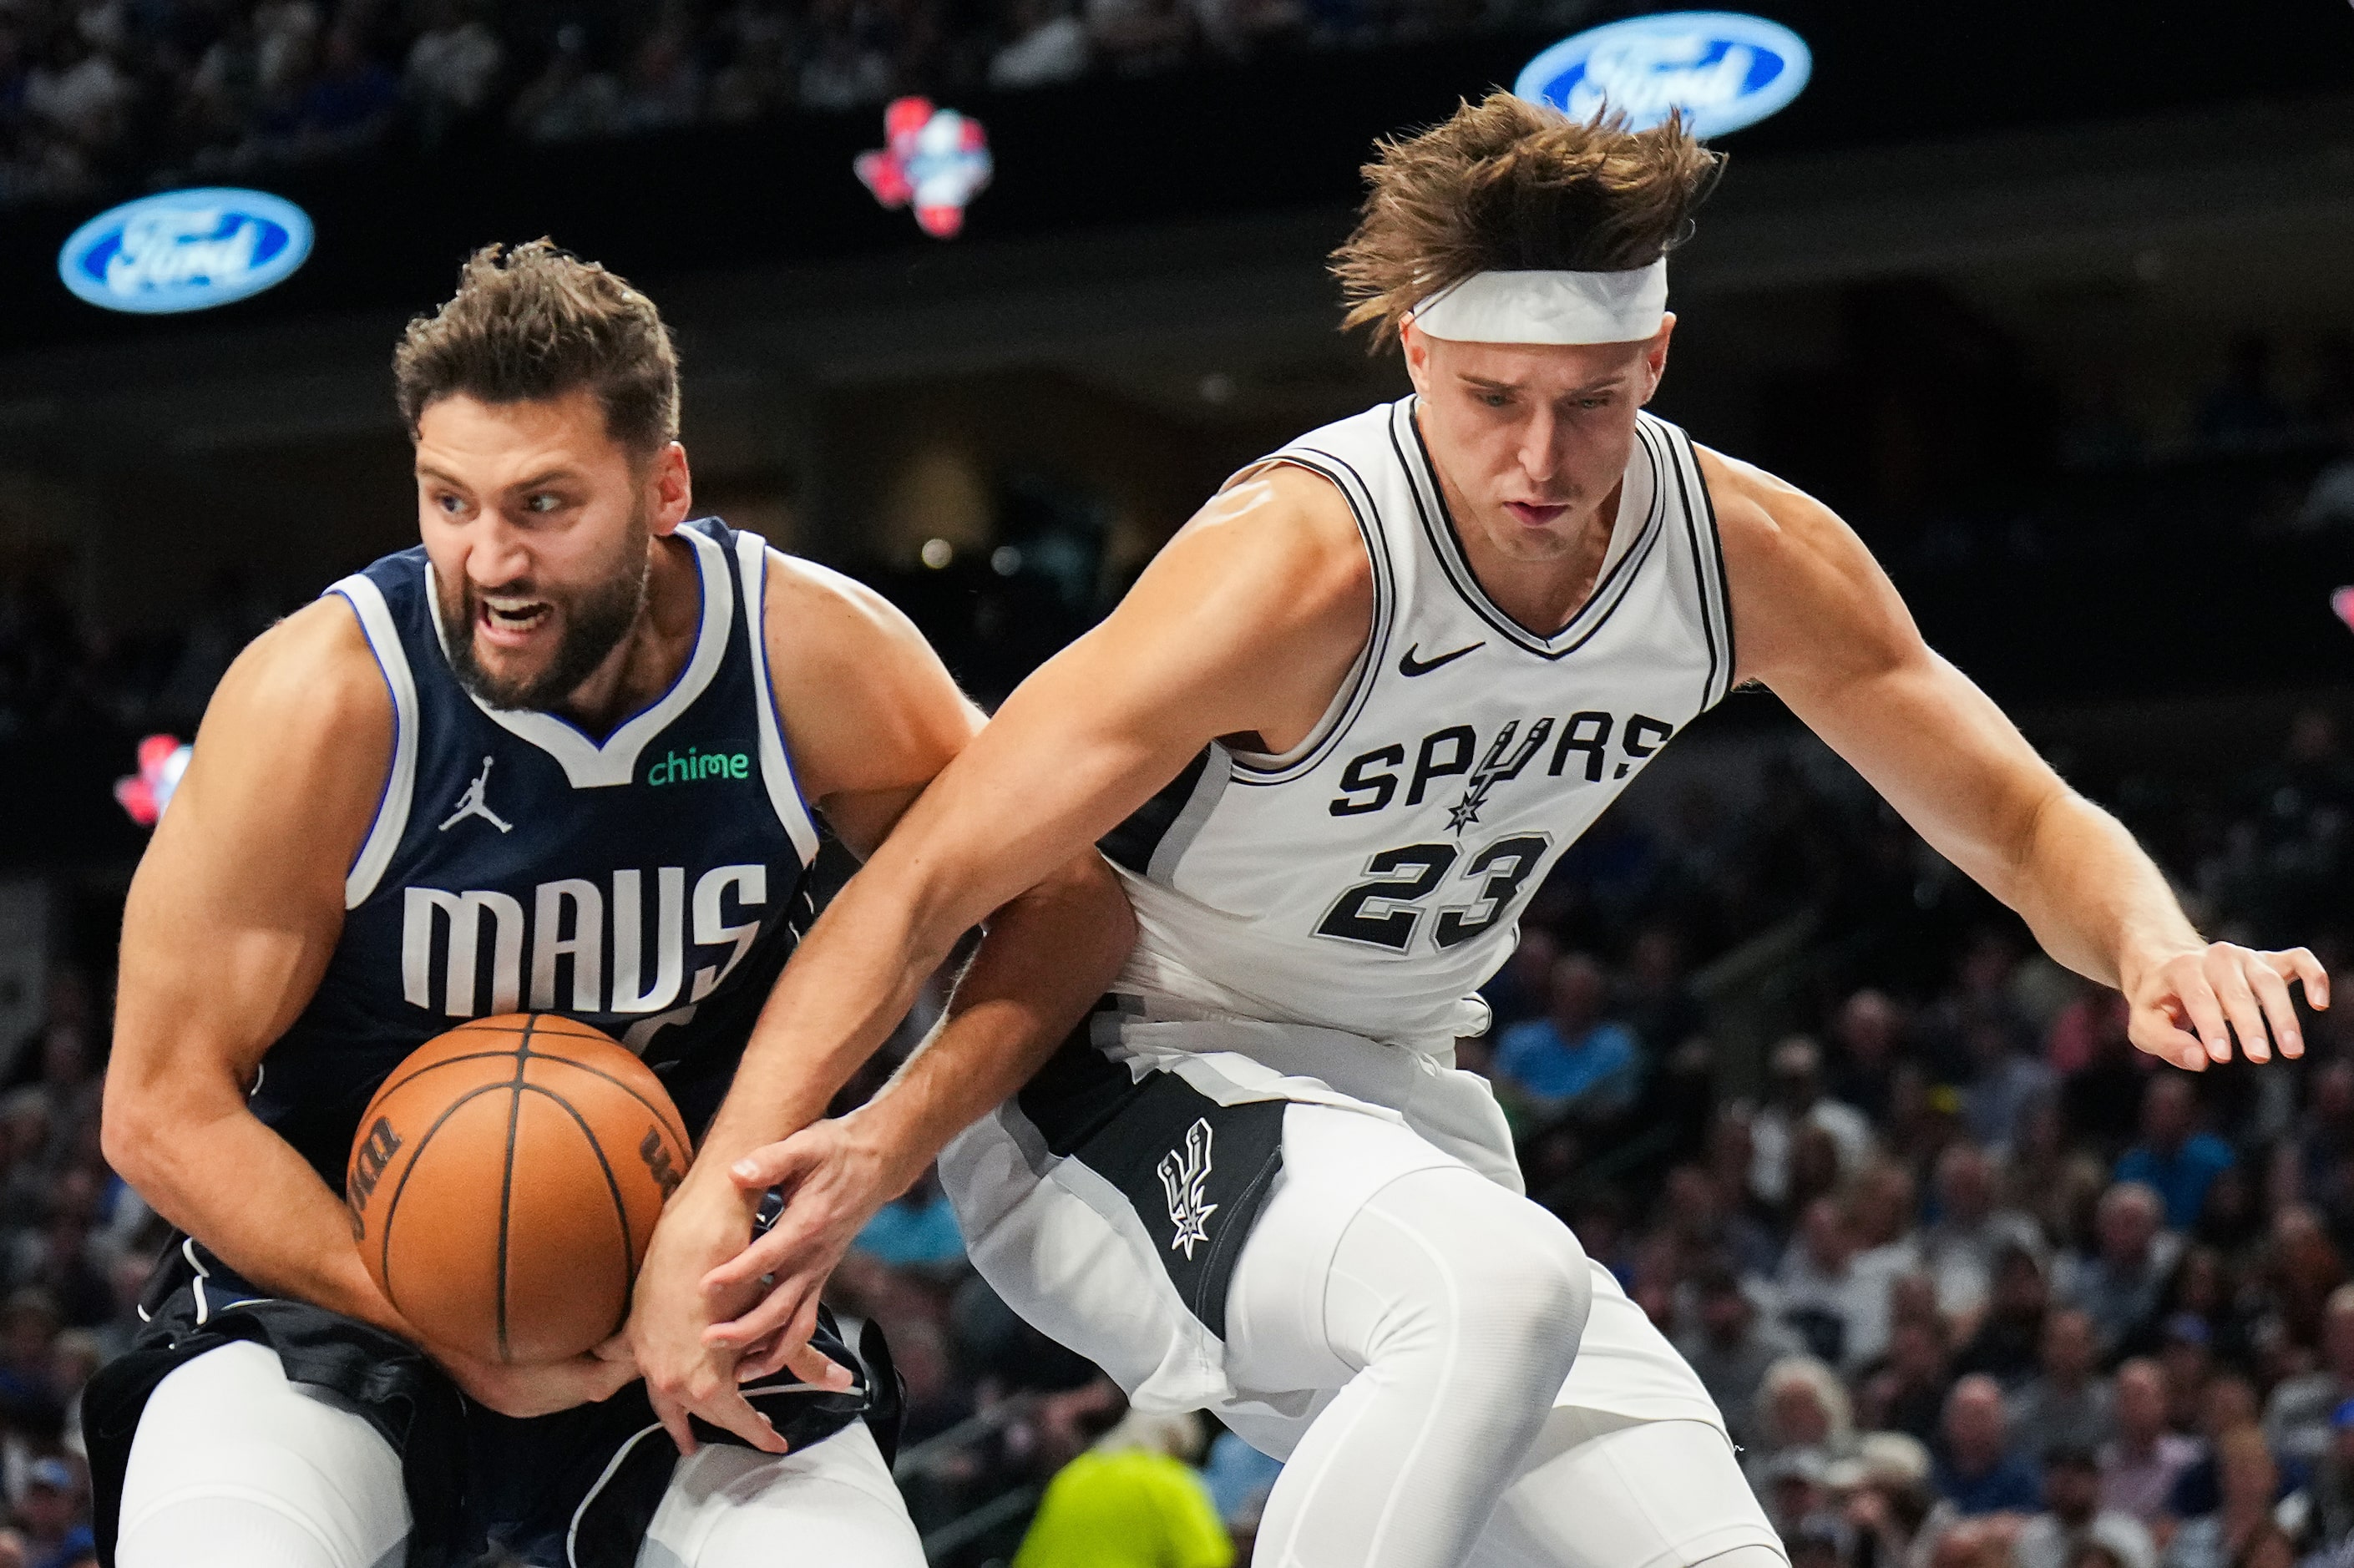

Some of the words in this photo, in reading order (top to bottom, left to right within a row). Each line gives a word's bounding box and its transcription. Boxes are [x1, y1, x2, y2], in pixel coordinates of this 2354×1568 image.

[1567, 35, 1752, 127] Ford
[108, 209, 257, 296] Ford
[648, 746, 749, 787] chime
[1329, 711, 1673, 837] SPURS
[1309, 831, 1554, 956] 23
